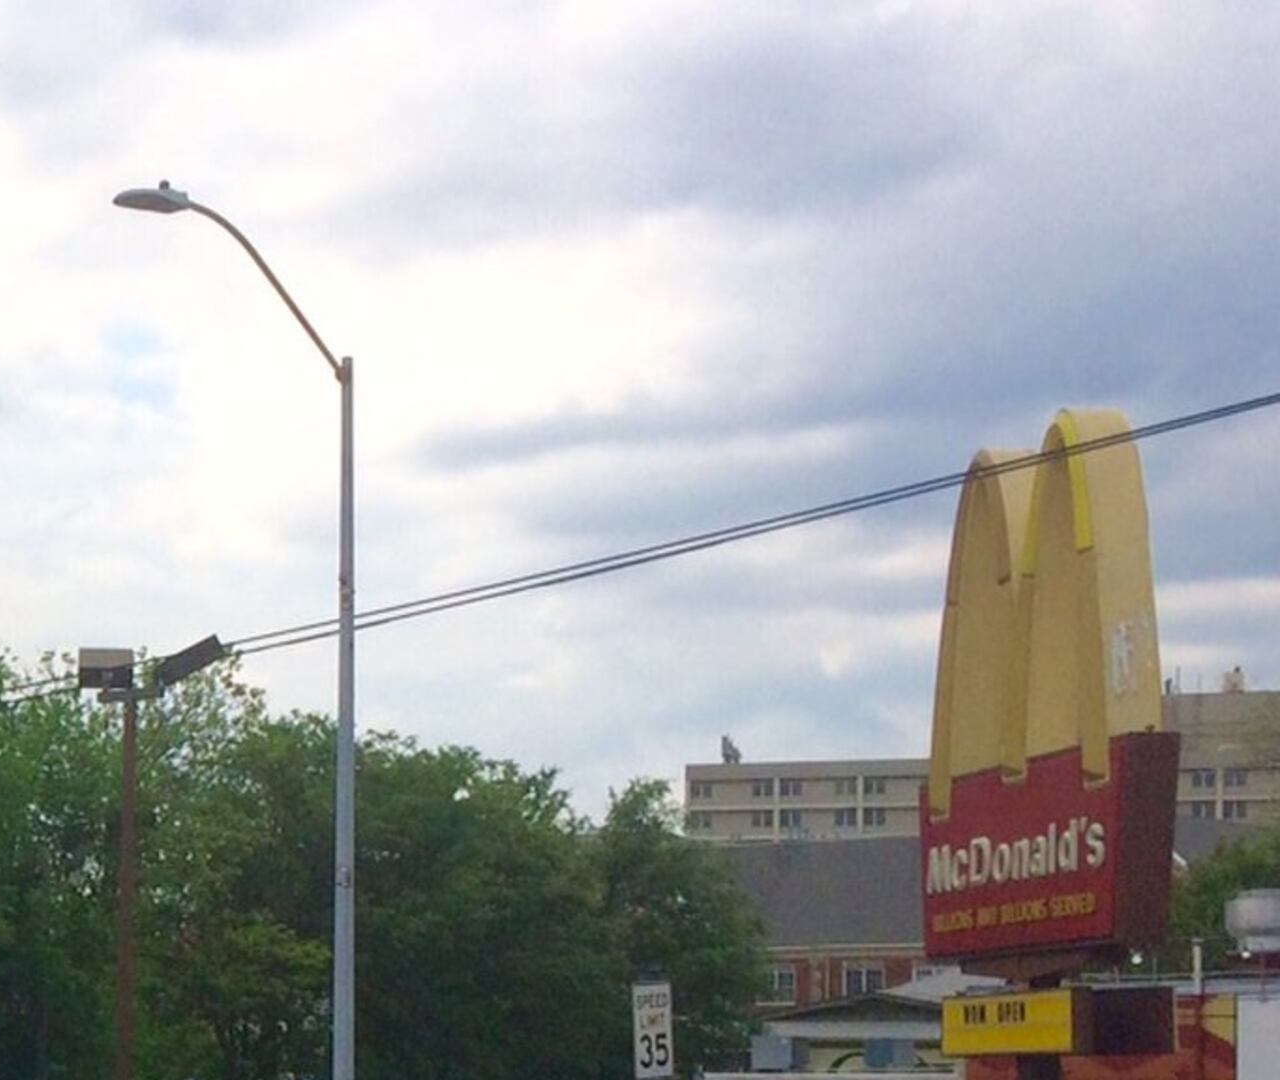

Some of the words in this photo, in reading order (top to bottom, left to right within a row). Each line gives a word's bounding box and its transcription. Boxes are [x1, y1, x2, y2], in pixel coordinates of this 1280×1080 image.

[926, 816, 1105, 894] McDonald's
[1049, 892, 1096, 918] SERVED
[636, 992, 668, 1010] SPEED
[997, 1000, 1026, 1023] OPEN
[640, 1012, 666, 1030] LIMIT
[640, 1032, 670, 1069] 35
